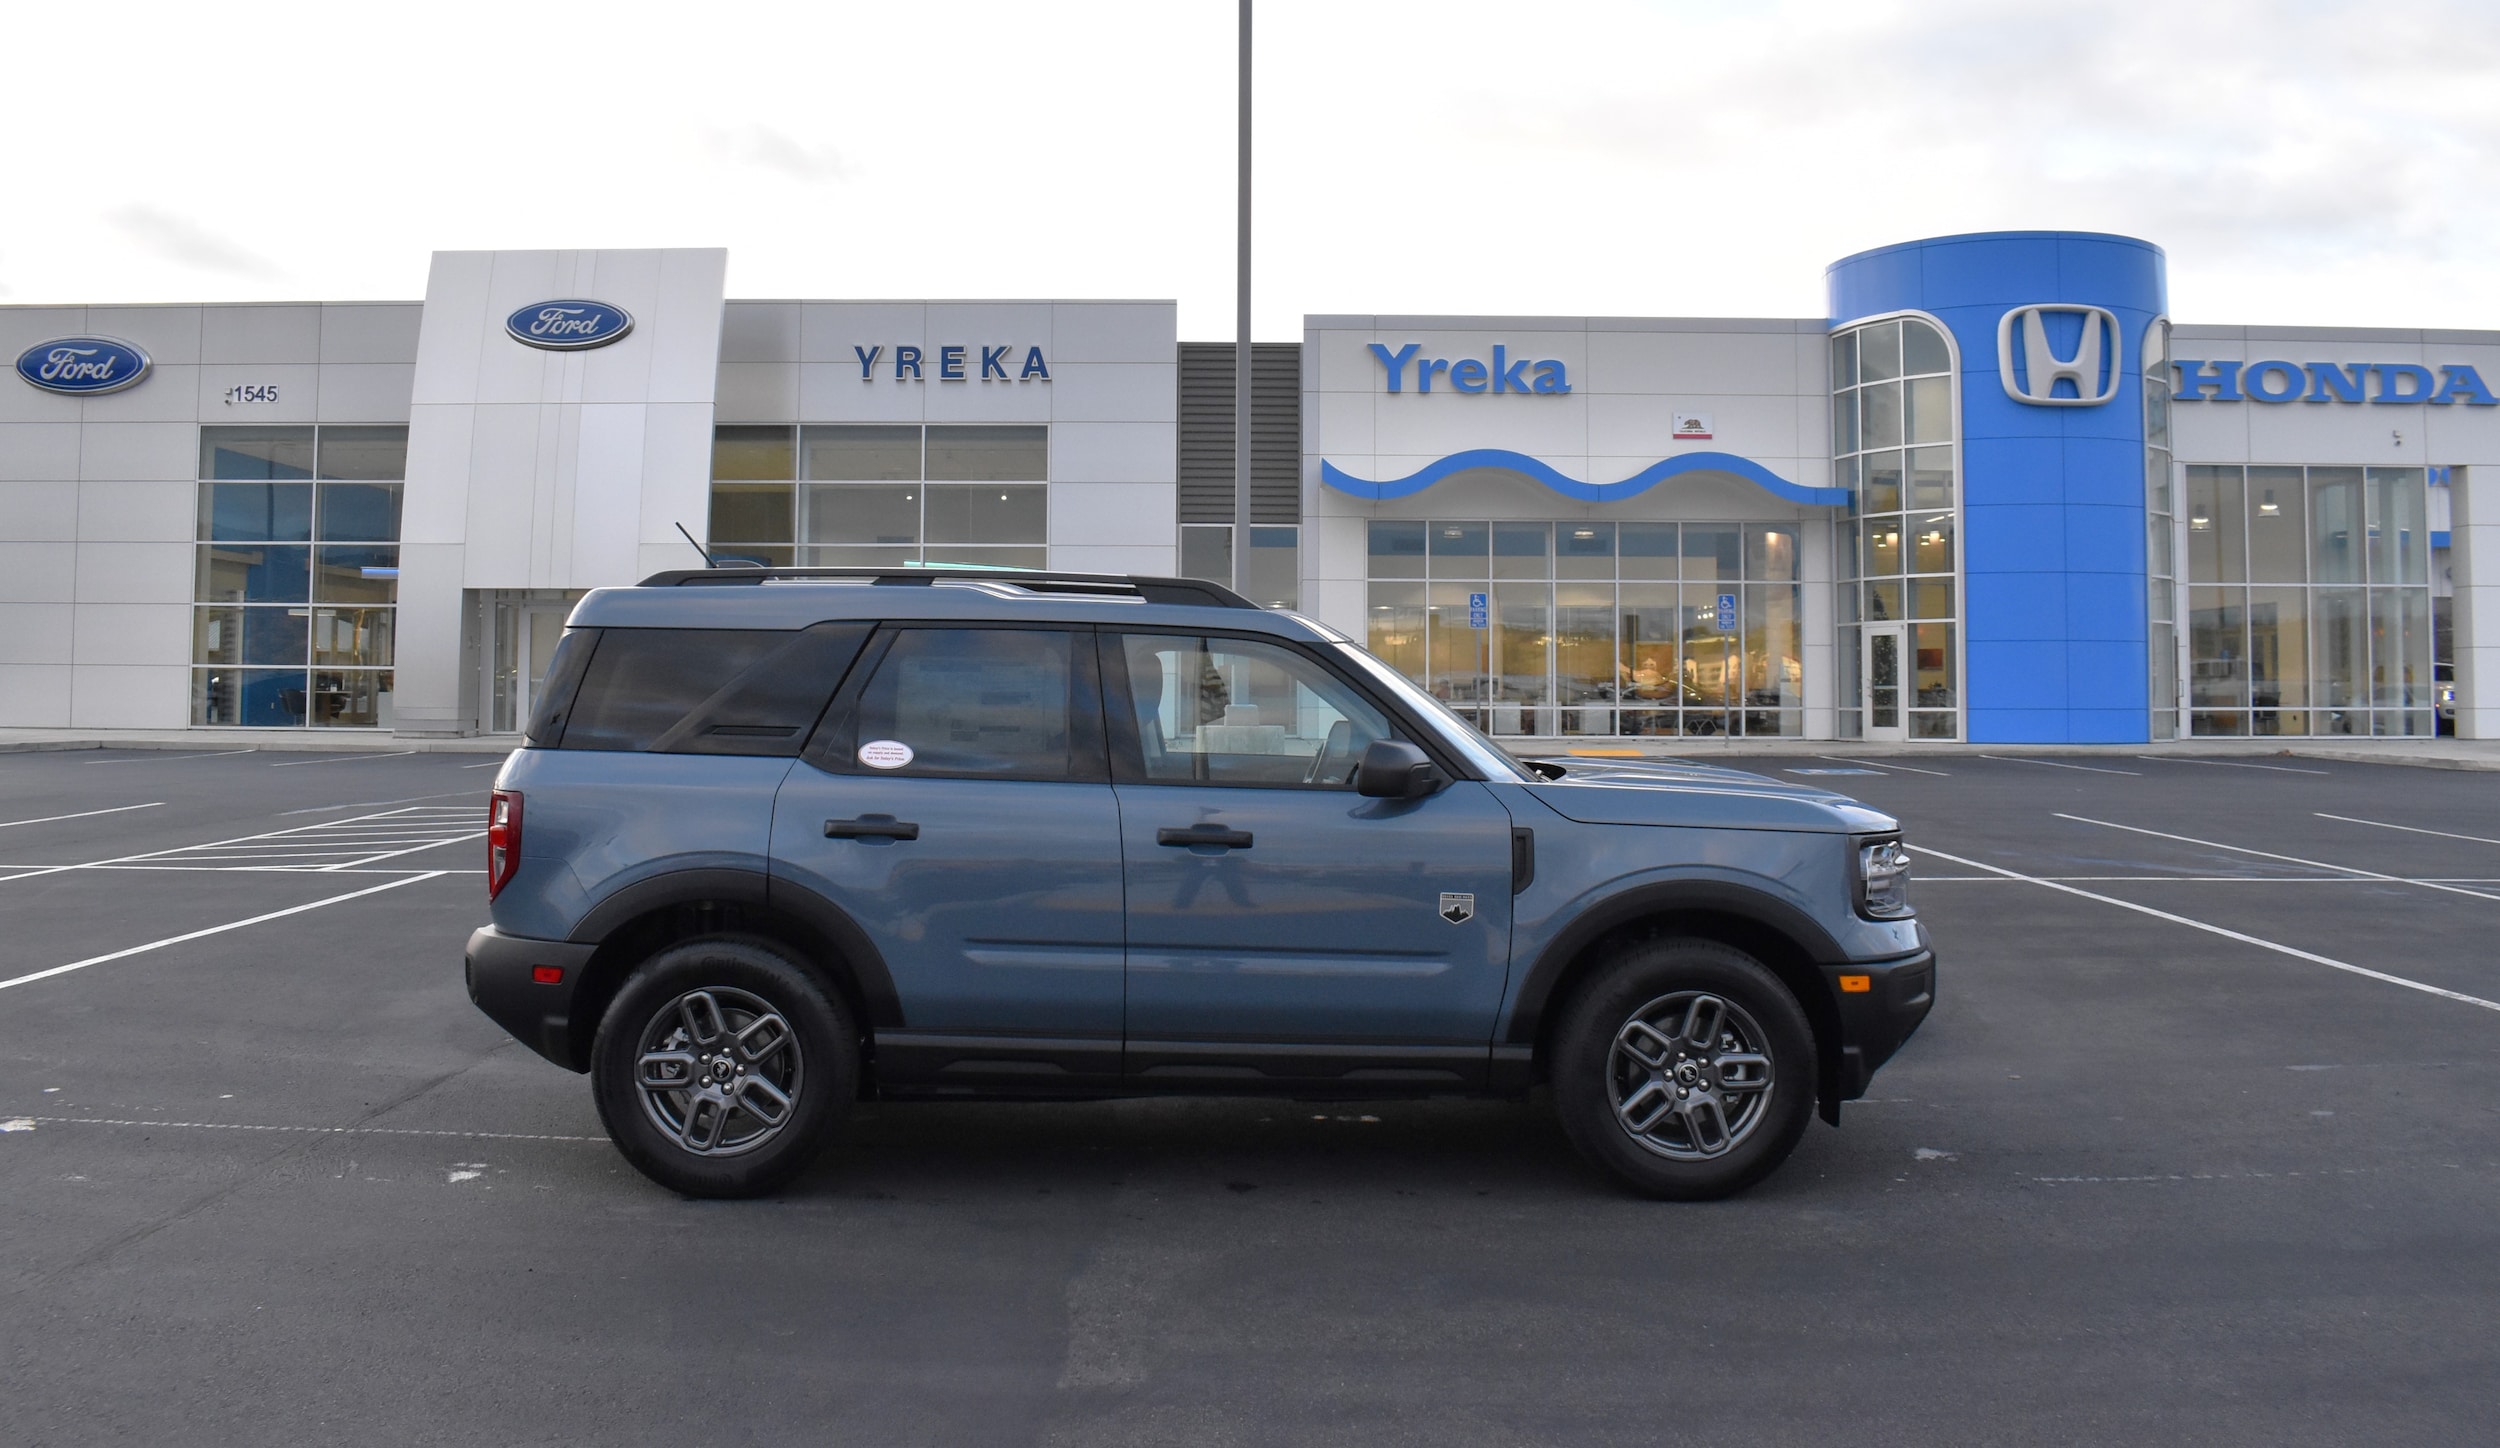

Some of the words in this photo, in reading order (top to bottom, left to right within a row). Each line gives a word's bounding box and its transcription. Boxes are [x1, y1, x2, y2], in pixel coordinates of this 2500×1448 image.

[530, 307, 602, 335] Ford
[40, 347, 116, 380] Ford
[853, 345, 1052, 381] YREKA
[1367, 343, 1572, 394] Yreka
[234, 385, 278, 402] 1545
[2171, 359, 2499, 405] HONDA
